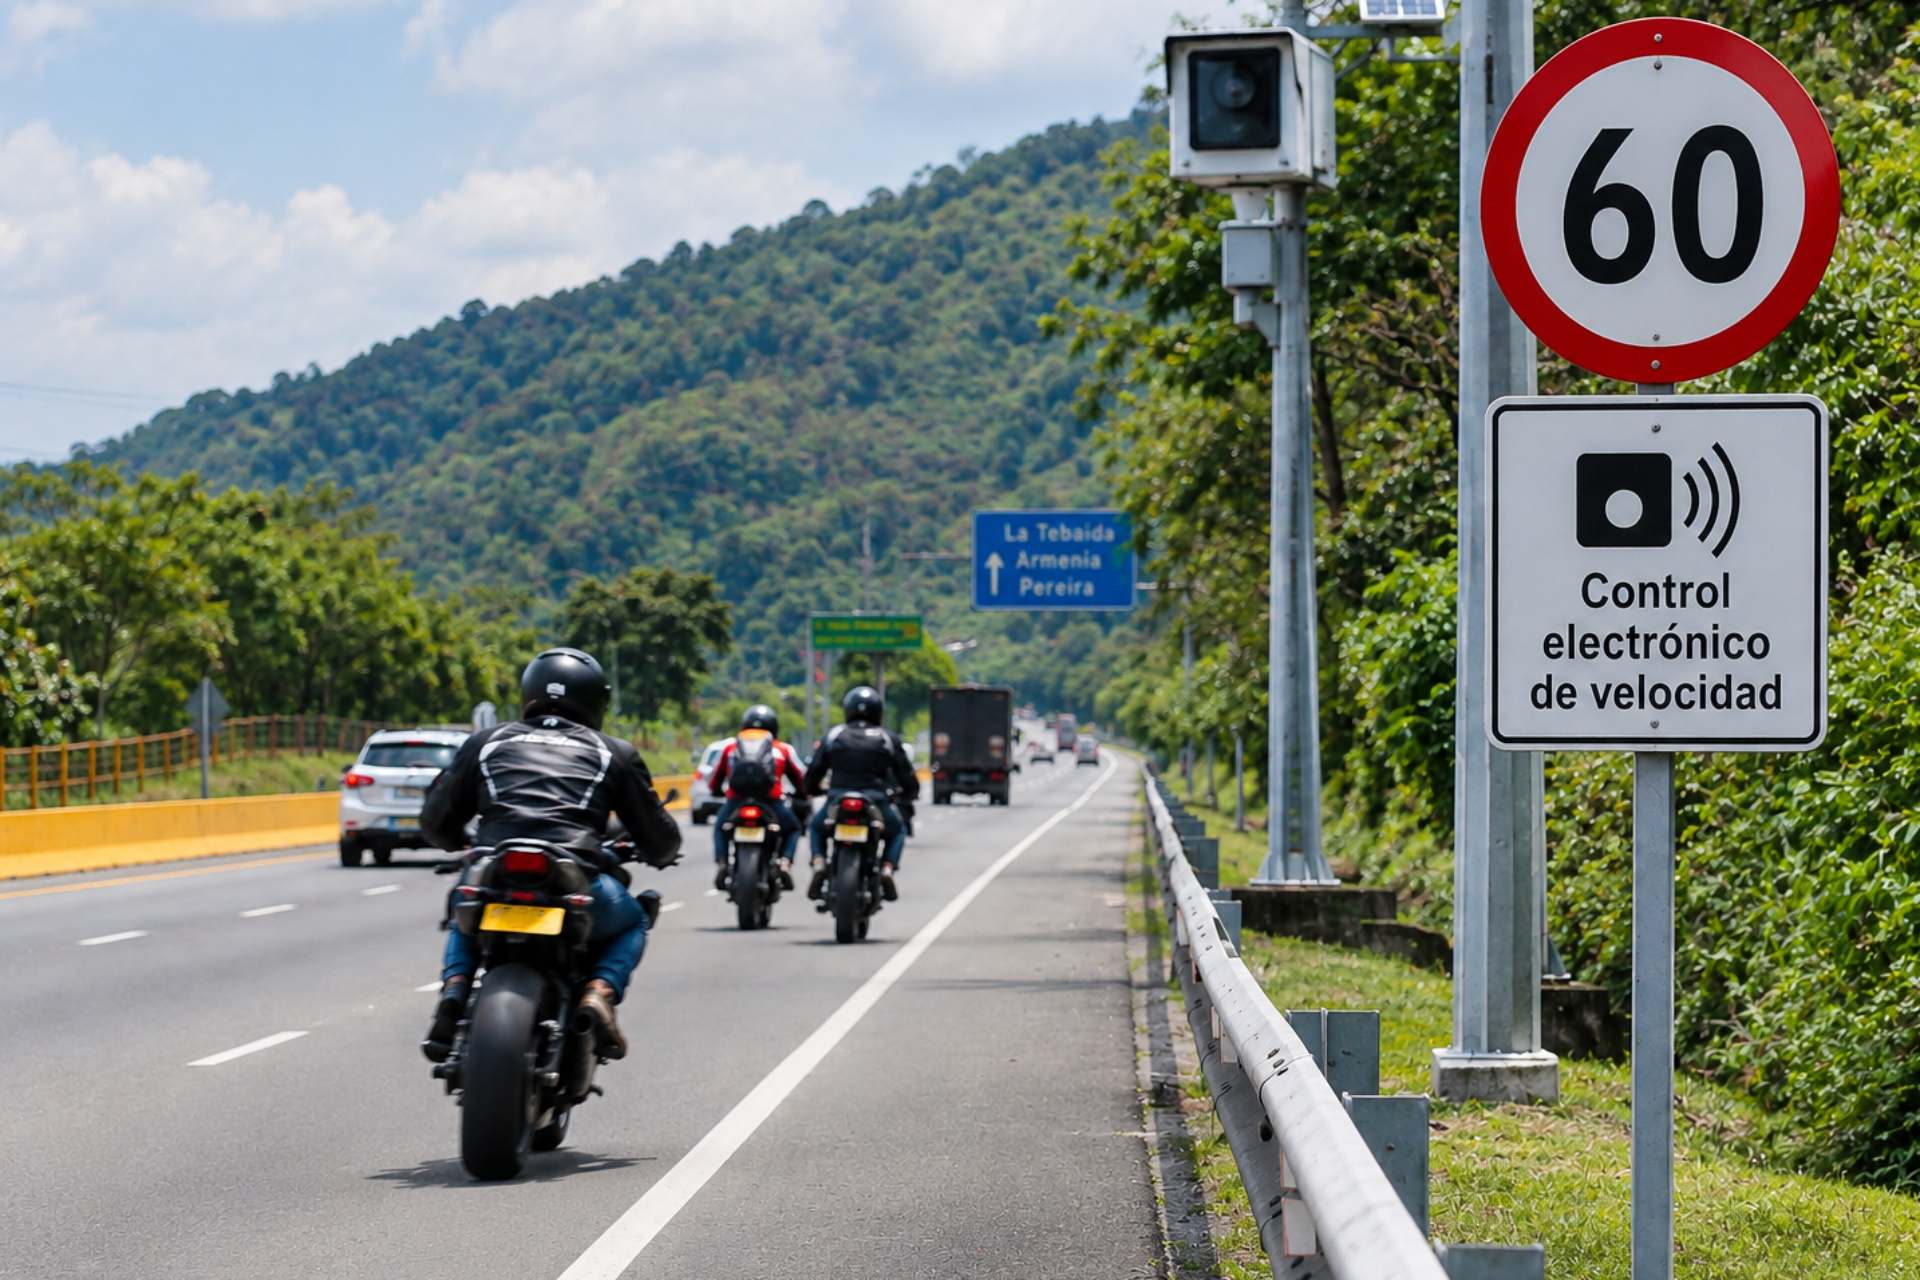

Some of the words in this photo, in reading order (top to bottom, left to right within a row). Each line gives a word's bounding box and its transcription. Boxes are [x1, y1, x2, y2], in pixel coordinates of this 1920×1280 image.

[1563, 125, 1763, 284] 60
[1004, 523, 1029, 542] La
[1037, 523, 1115, 542] Tebaida
[1017, 550, 1101, 569] Armenia
[1020, 576, 1094, 596] Pereira
[1581, 572, 1730, 608] Control
[1543, 623, 1770, 659] electrónico
[1530, 674, 1577, 709] de
[1590, 674, 1782, 709] velocidad
